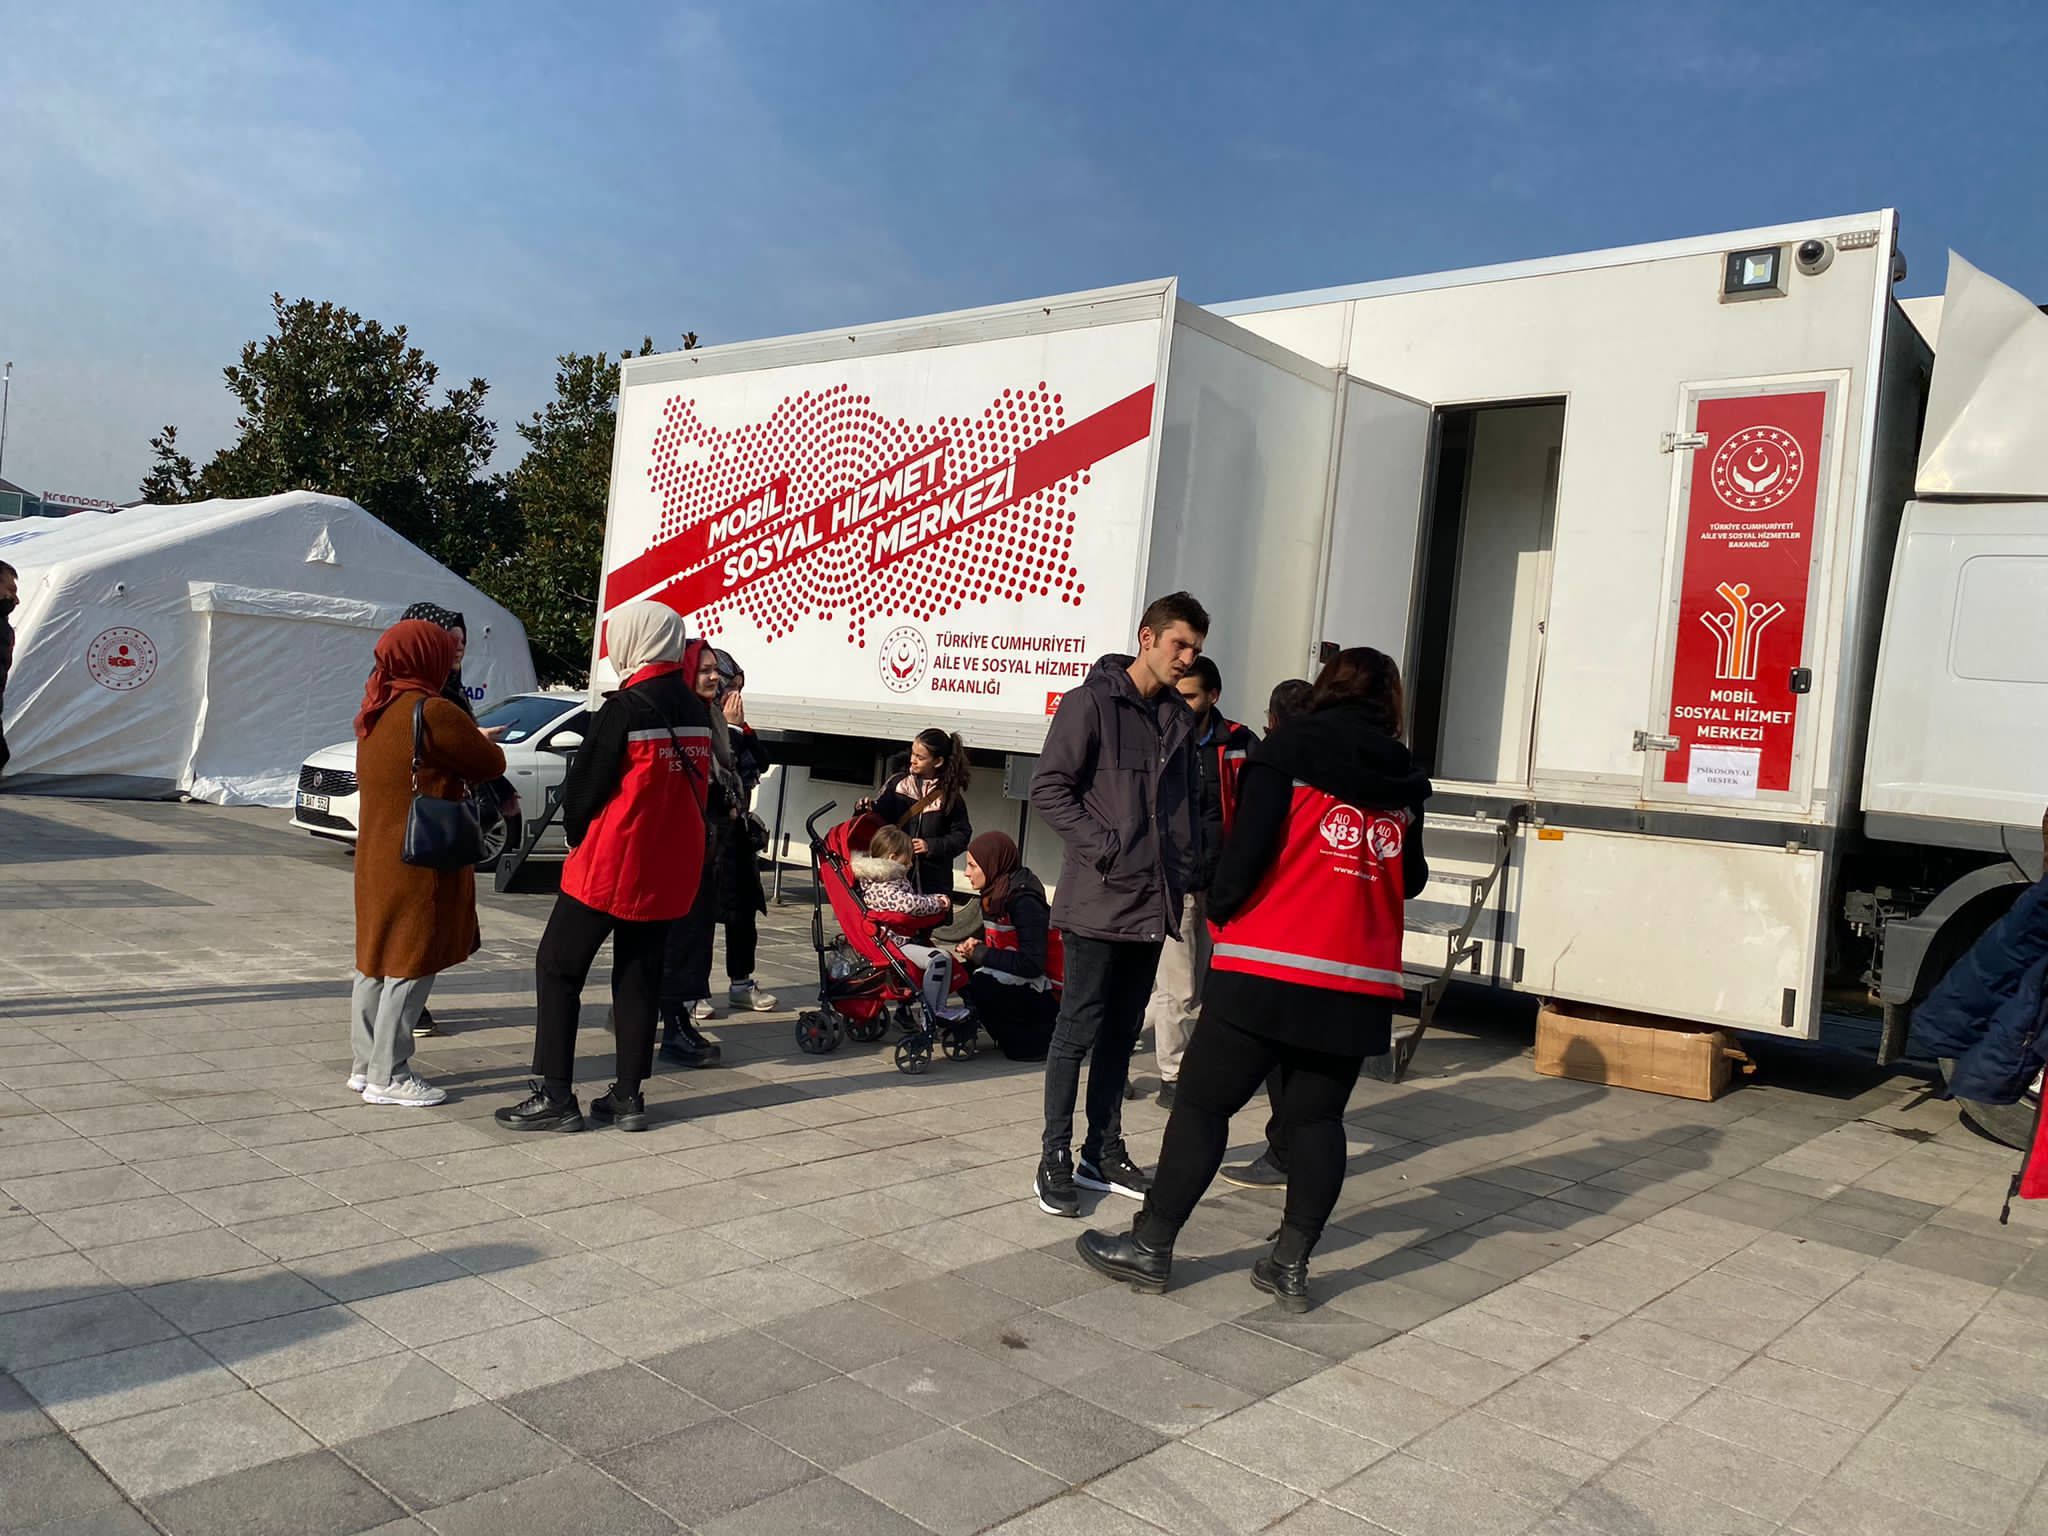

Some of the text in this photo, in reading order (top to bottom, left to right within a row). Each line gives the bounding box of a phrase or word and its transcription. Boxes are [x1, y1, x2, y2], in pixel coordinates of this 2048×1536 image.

[708, 486, 783, 549] MOBİL
[722, 448, 944, 588] SOSYAL HİZMET
[874, 456, 1017, 564] MERKEZİ
[1701, 532, 1716, 540] AİLE
[1757, 531, 1801, 539] HİZMETLER
[1710, 522, 1793, 531] TÜRKİYE CUMHURİYETİ
[1728, 541, 1769, 549] BAKANLIĞI
[936, 631, 1086, 653] TÜRKİYE CUMHURİYETİ
[933, 653, 1094, 677] AİLE VE SOSYAL HİZMET
[931, 677, 1001, 695] BAKANLIĞI
[1710, 688, 1758, 704] MOBİL
[1674, 706, 1792, 724] SOSYAL HİZMET
[1697, 725, 1764, 741] MERKEZİ
[1333, 813, 1351, 825] ALO
[1328, 823, 1359, 843] 183
[1376, 824, 1392, 838] ALO
